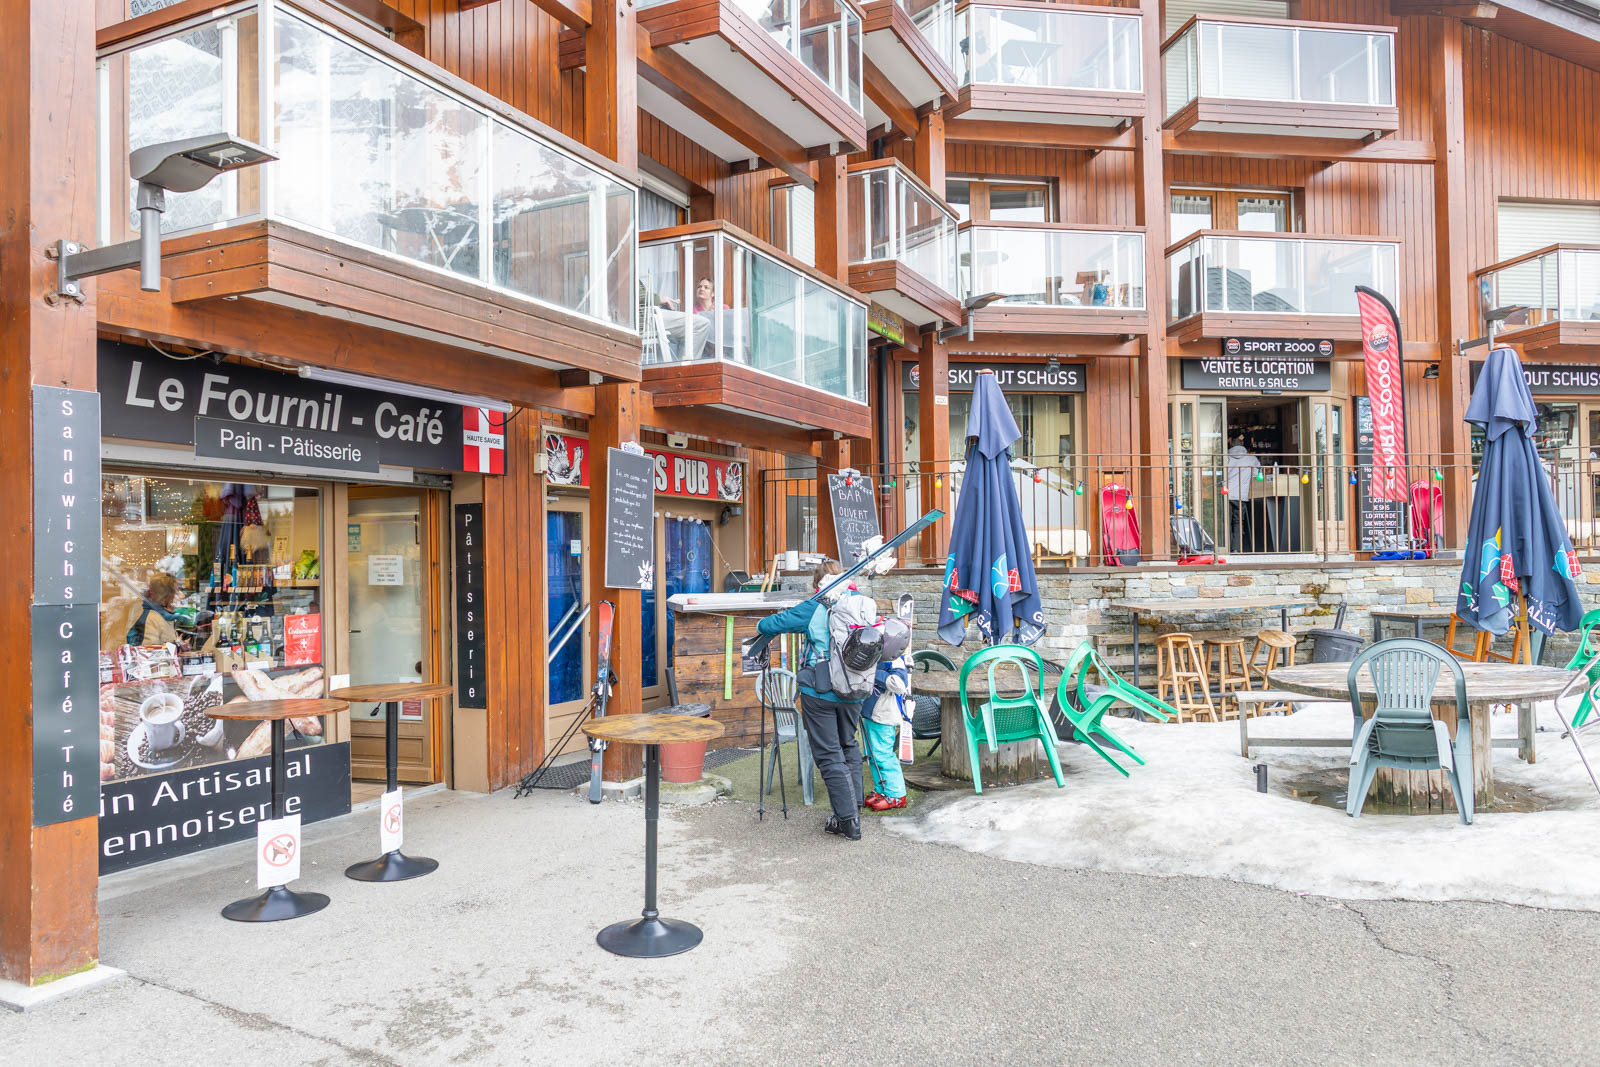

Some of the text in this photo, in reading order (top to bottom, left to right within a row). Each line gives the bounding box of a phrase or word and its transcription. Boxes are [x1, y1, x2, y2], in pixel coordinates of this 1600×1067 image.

[1243, 341, 1316, 352] SPORT 2000
[948, 369, 972, 384] SKI
[975, 369, 1015, 385] UT
[1200, 360, 1315, 375] VENTE & LOCATION
[1523, 371, 1600, 387] OUT SCHUS
[1218, 377, 1299, 388] RENTAL & SALES
[125, 360, 444, 445] Le Fournil - Café
[220, 428, 263, 452] Pain
[281, 435, 362, 462] Pâtisserie
[466, 434, 501, 445] HAUTE SAVOIE
[674, 456, 710, 495] PUB
[61, 400, 75, 600] Sandwichs
[839, 489, 862, 503] BAR
[838, 506, 869, 520] OUVERT
[465, 513, 476, 698] Pâtisserie
[59, 622, 73, 714] Café
[61, 745, 74, 813] Thé
[99, 792, 135, 818] in
[102, 794, 302, 858] ennoisere
